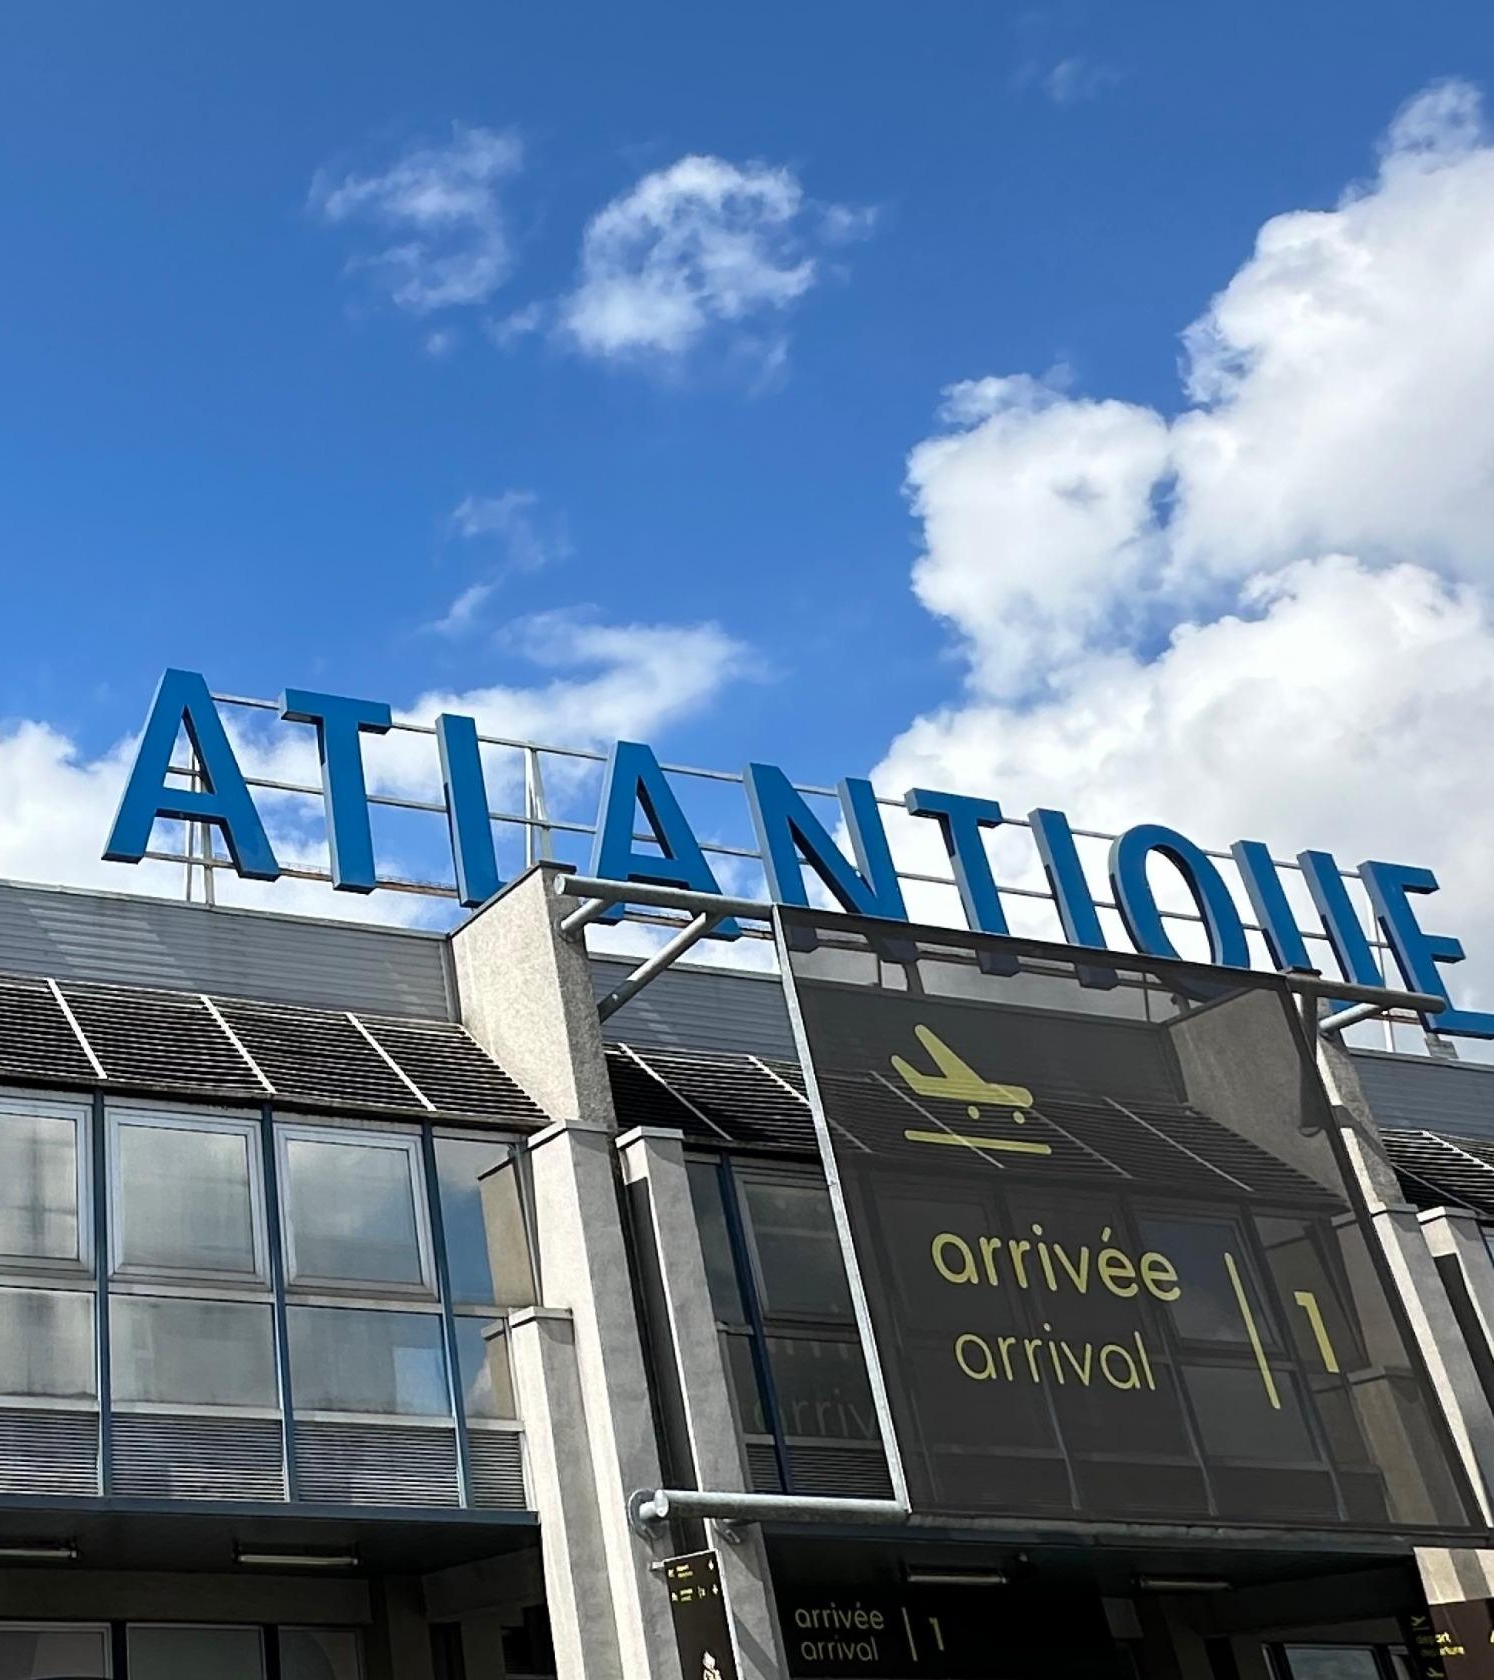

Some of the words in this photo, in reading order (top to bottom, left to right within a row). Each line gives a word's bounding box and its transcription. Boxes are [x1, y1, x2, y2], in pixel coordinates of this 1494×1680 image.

[931, 1224, 1181, 1301] arrivée
[1294, 1290, 1339, 1374] 1
[955, 1323, 1156, 1391] arrival
[794, 1602, 885, 1630] arrivée
[929, 1616, 945, 1652] 1
[800, 1634, 879, 1662] arrival
